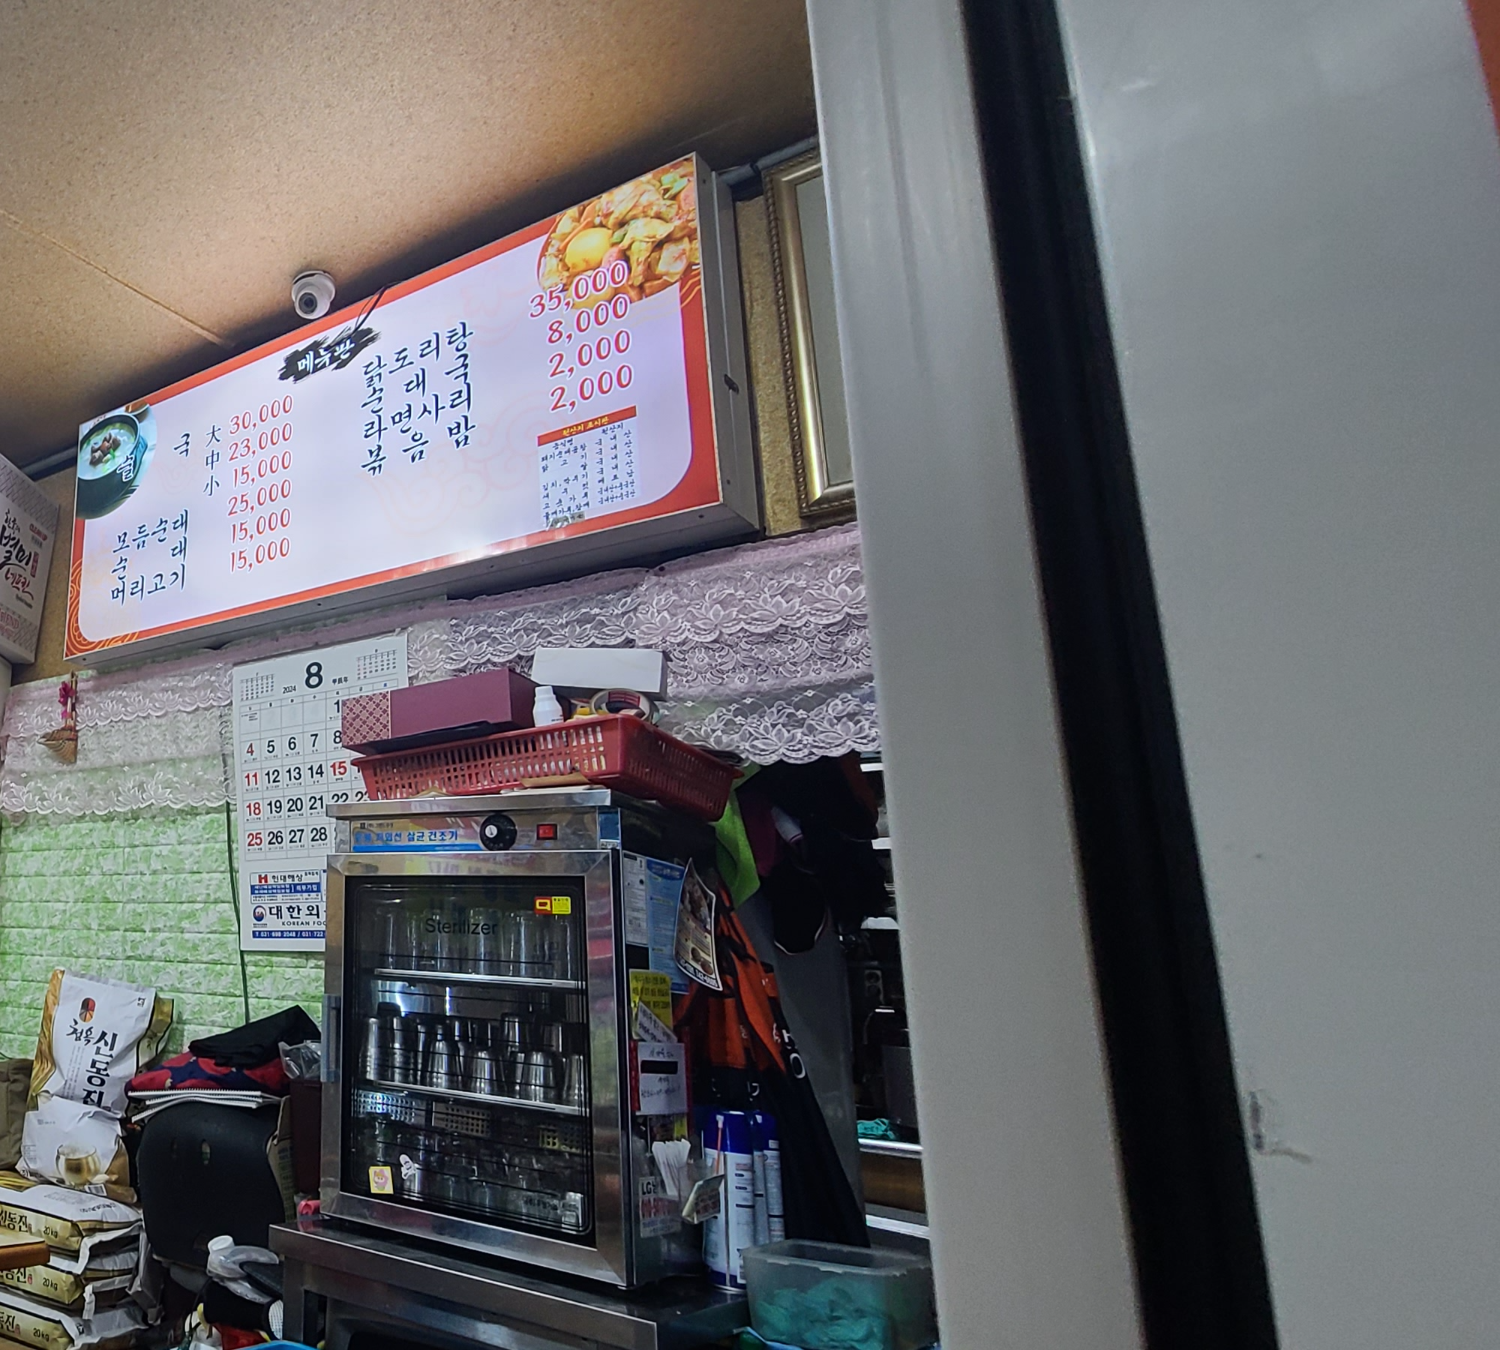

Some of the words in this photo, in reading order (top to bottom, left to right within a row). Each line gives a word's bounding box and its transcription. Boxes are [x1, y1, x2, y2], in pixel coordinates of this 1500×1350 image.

[529, 262, 628, 319] 35,000
[547, 295, 630, 344] 8,000
[297, 339, 355, 374] 메뉴판
[362, 321, 474, 389] 닭도리탕
[549, 330, 631, 378] 2,000
[363, 382, 472, 441] 라면사리
[550, 365, 633, 412] 2,000
[206, 425, 221, 447] 大
[229, 395, 293, 435] 30,000
[206, 450, 220, 471] 中
[228, 423, 293, 462] 23,000
[204, 474, 220, 496] 小
[233, 450, 292, 487] 15,000
[113, 509, 190, 553] 모듬순대
[228, 479, 292, 517] 25,000
[231, 508, 291, 543] 15,000
[111, 564, 186, 606] 머리고기
[230, 537, 290, 572] 15,000
[304, 662, 323, 689] 8
[246, 743, 254, 756] 4
[267, 740, 275, 753] 5
[288, 737, 296, 750] 6
[310, 733, 318, 748] 7
[333, 730, 342, 744] 8
[245, 772, 258, 786] 11
[265, 769, 280, 784] 12
[286, 766, 302, 781] 13
[307, 763, 324, 779] 14
[330, 761, 347, 776] 15
[246, 802, 261, 816] 18
[267, 800, 282, 814] 19
[287, 798, 303, 812] 20
[309, 795, 324, 810] 21
[247, 832, 262, 846] 25
[268, 831, 283, 845] 26
[289, 829, 304, 843] 27
[310, 827, 327, 842] 28
[268, 904, 326, 920] 대한외
[425, 917, 498, 936] Sterilizer
